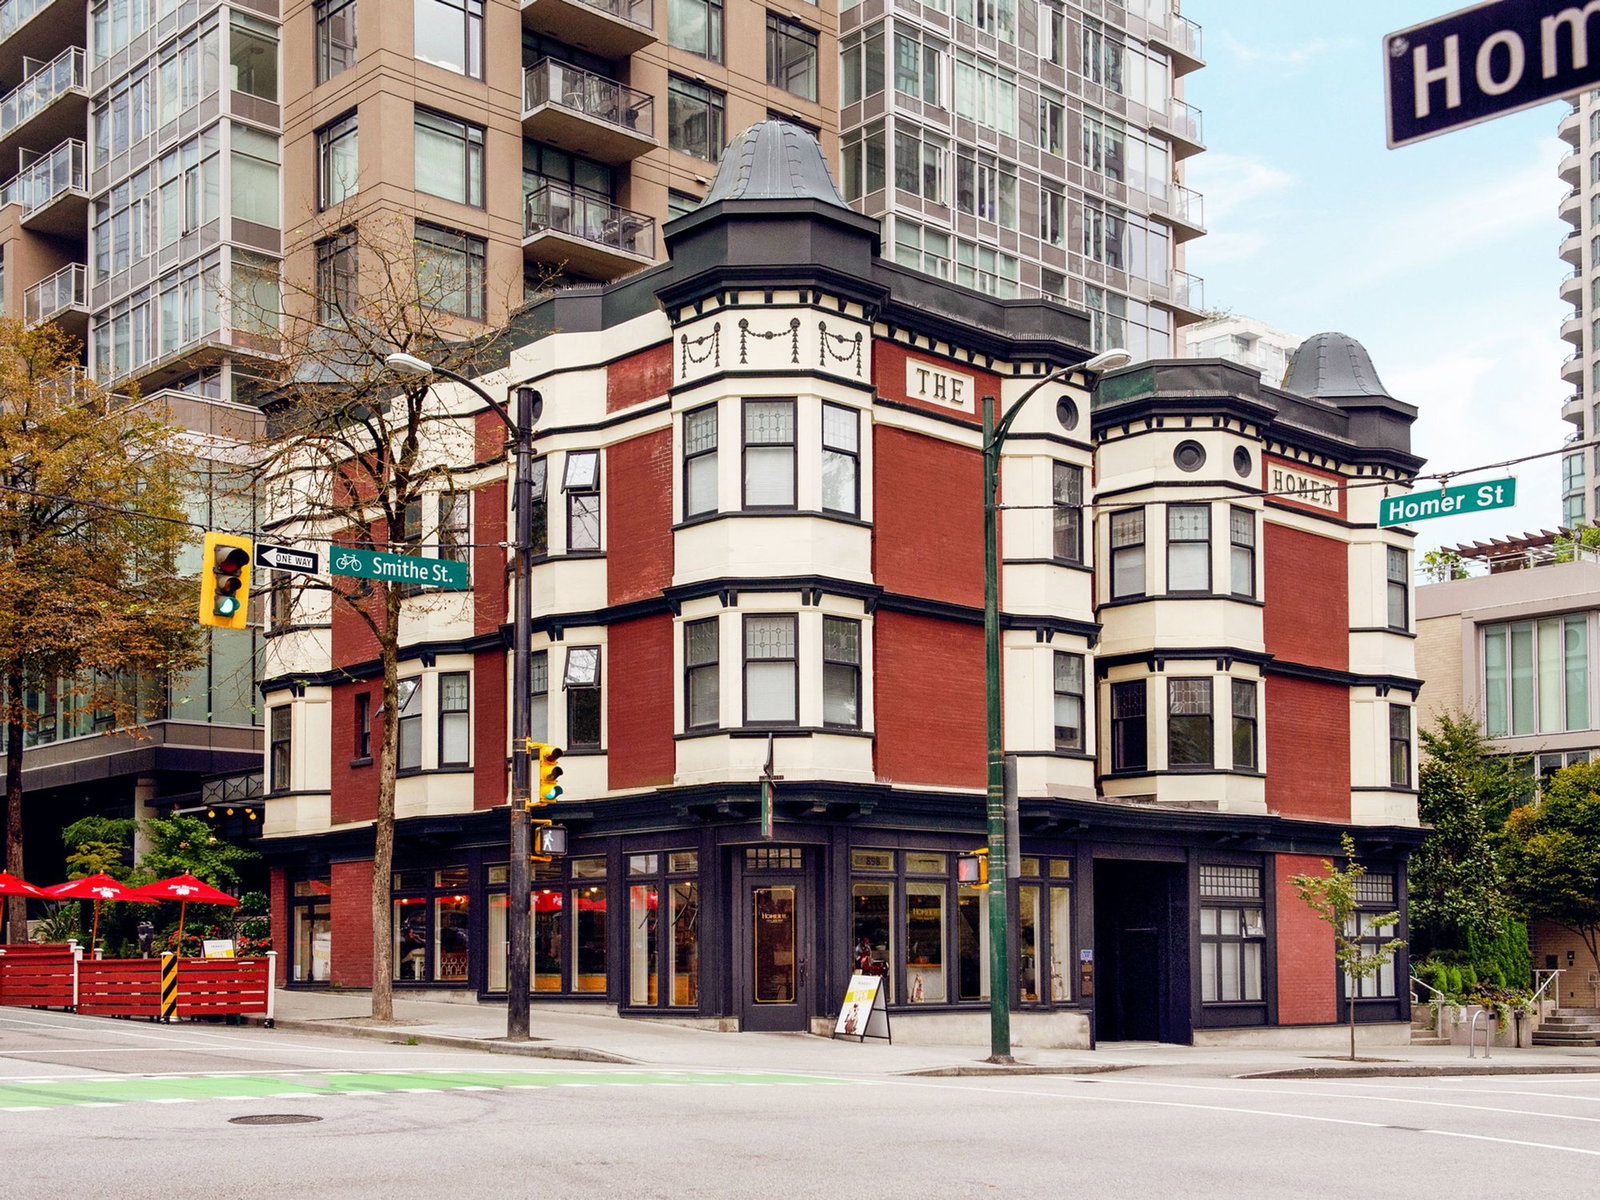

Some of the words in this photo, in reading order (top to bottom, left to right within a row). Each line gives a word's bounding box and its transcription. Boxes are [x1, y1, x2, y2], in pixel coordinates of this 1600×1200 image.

[917, 368, 964, 404] THE
[1273, 469, 1333, 505] HOMER
[1388, 494, 1466, 521] Homer
[1476, 484, 1504, 507] St
[275, 553, 293, 564] ONE
[294, 556, 313, 568] WAY
[372, 556, 429, 580] Smithe
[432, 563, 454, 583] St.
